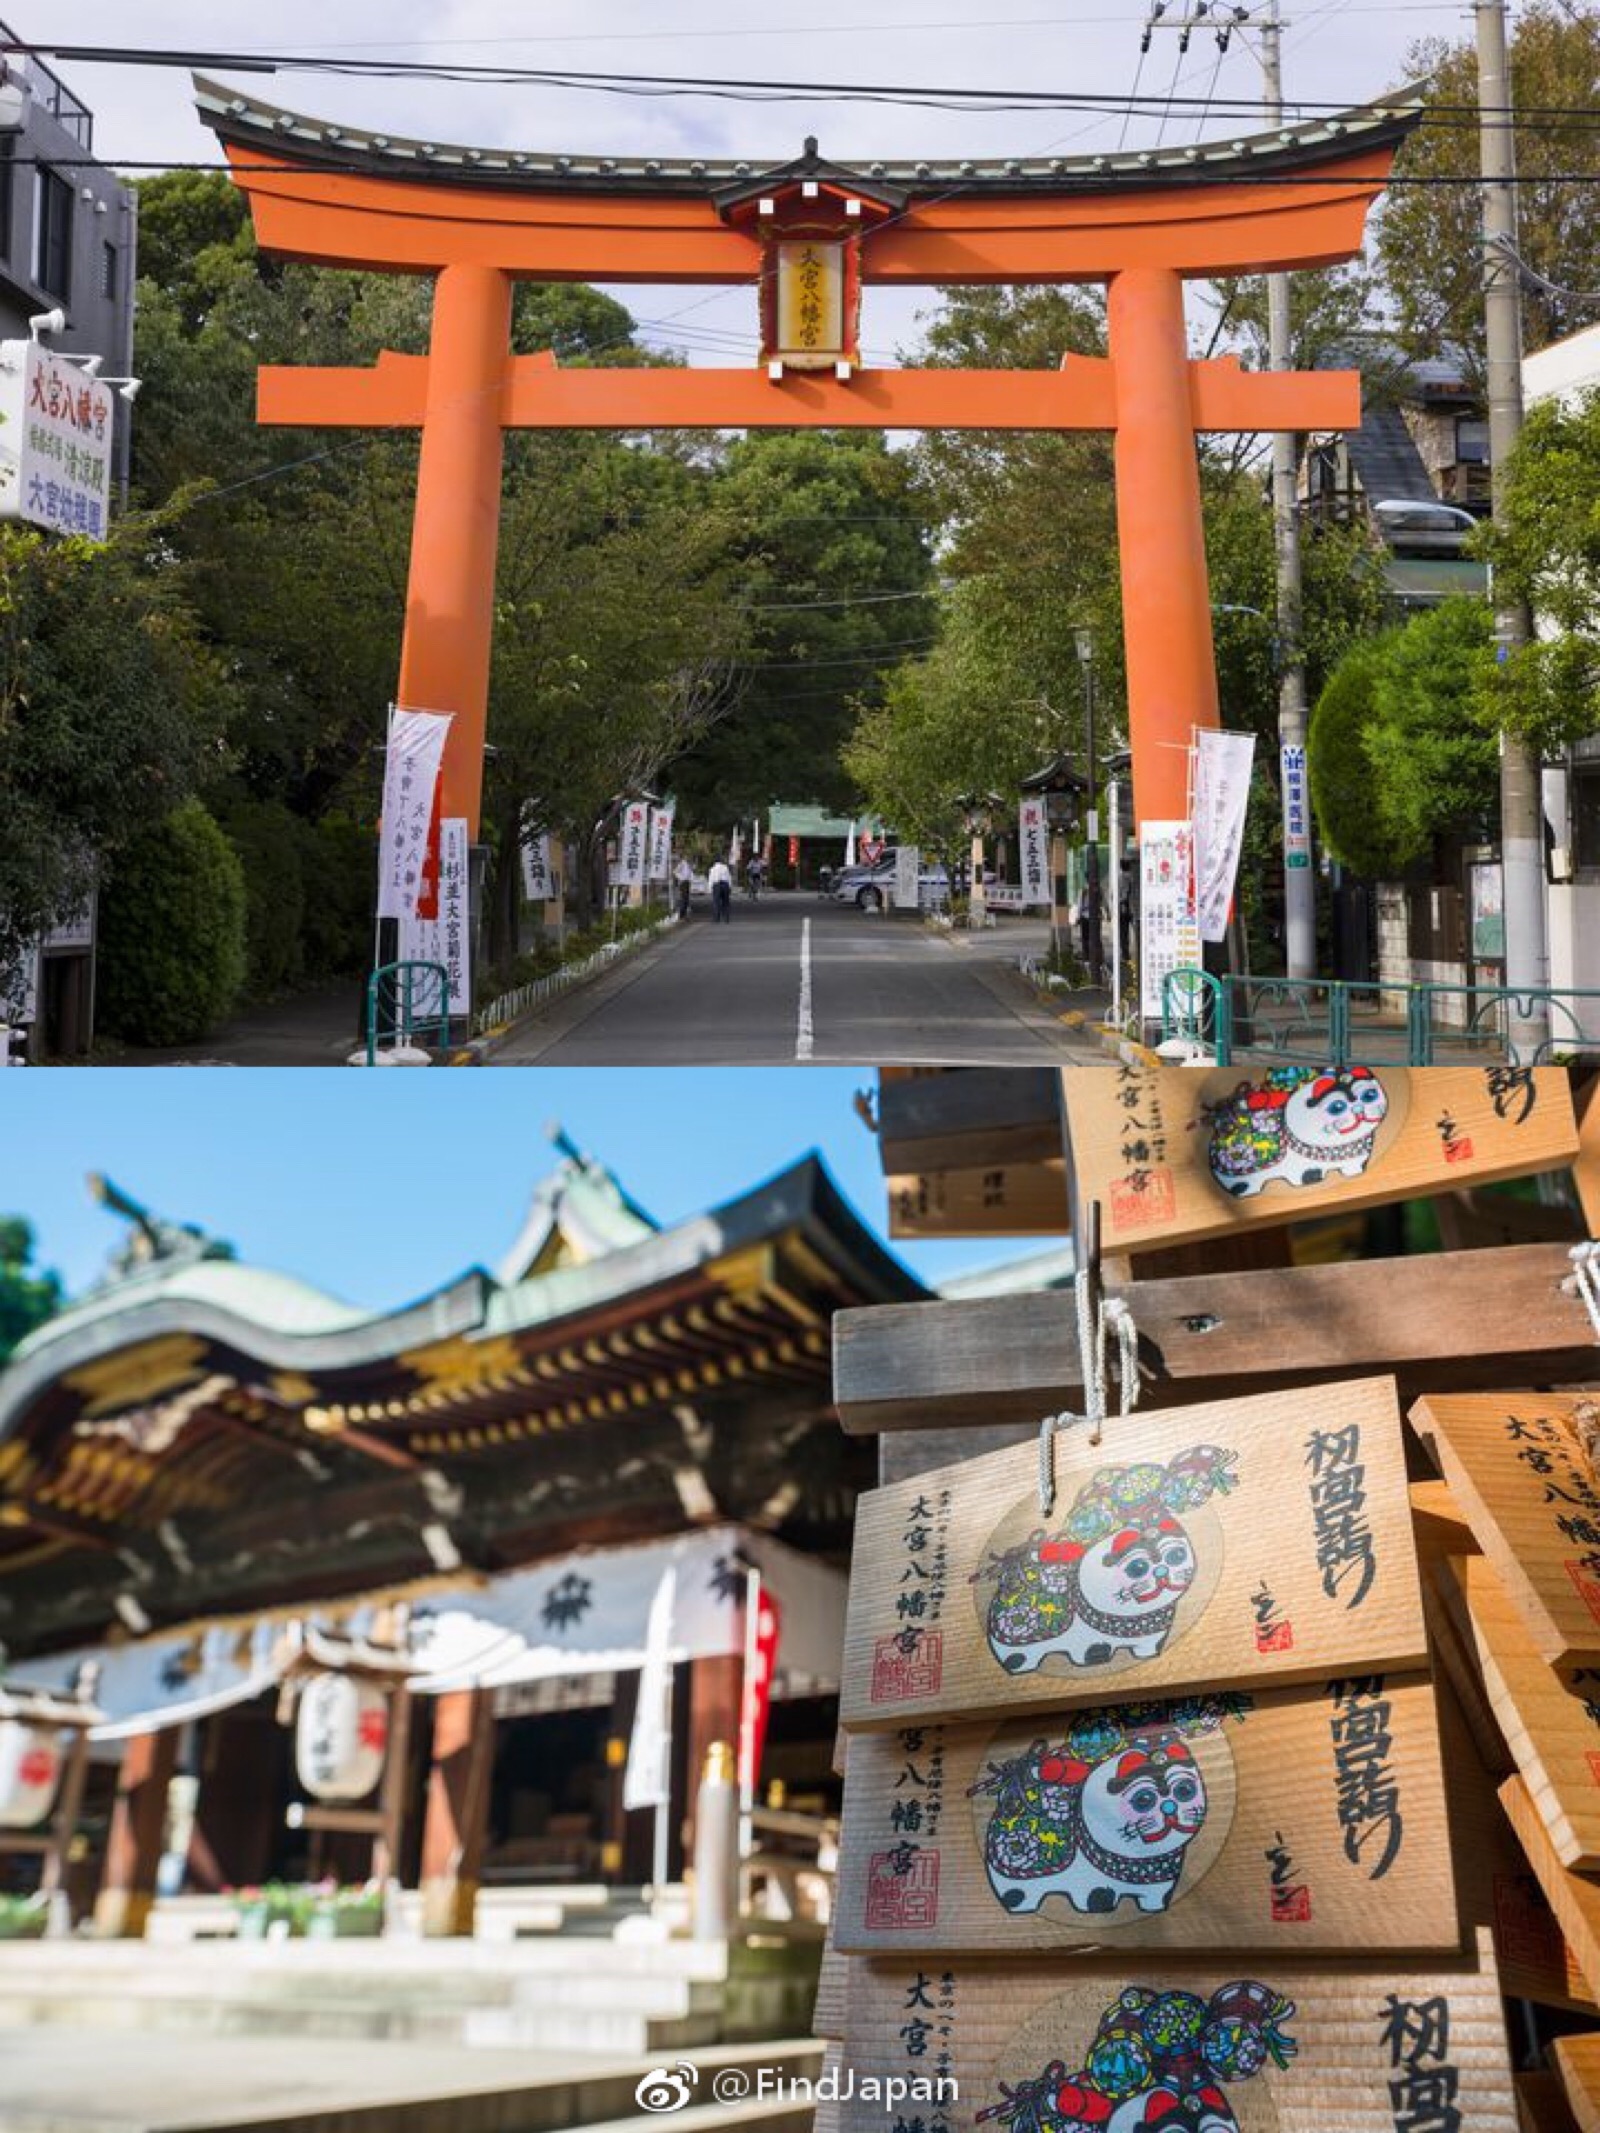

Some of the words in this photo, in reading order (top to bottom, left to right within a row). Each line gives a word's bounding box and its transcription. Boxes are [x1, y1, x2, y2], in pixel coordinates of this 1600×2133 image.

[800, 248, 821, 347] 大宮八幡宮
[30, 360, 108, 442] 大宮八幡宮
[893, 1494, 934, 1655] 大宮八幡宮
